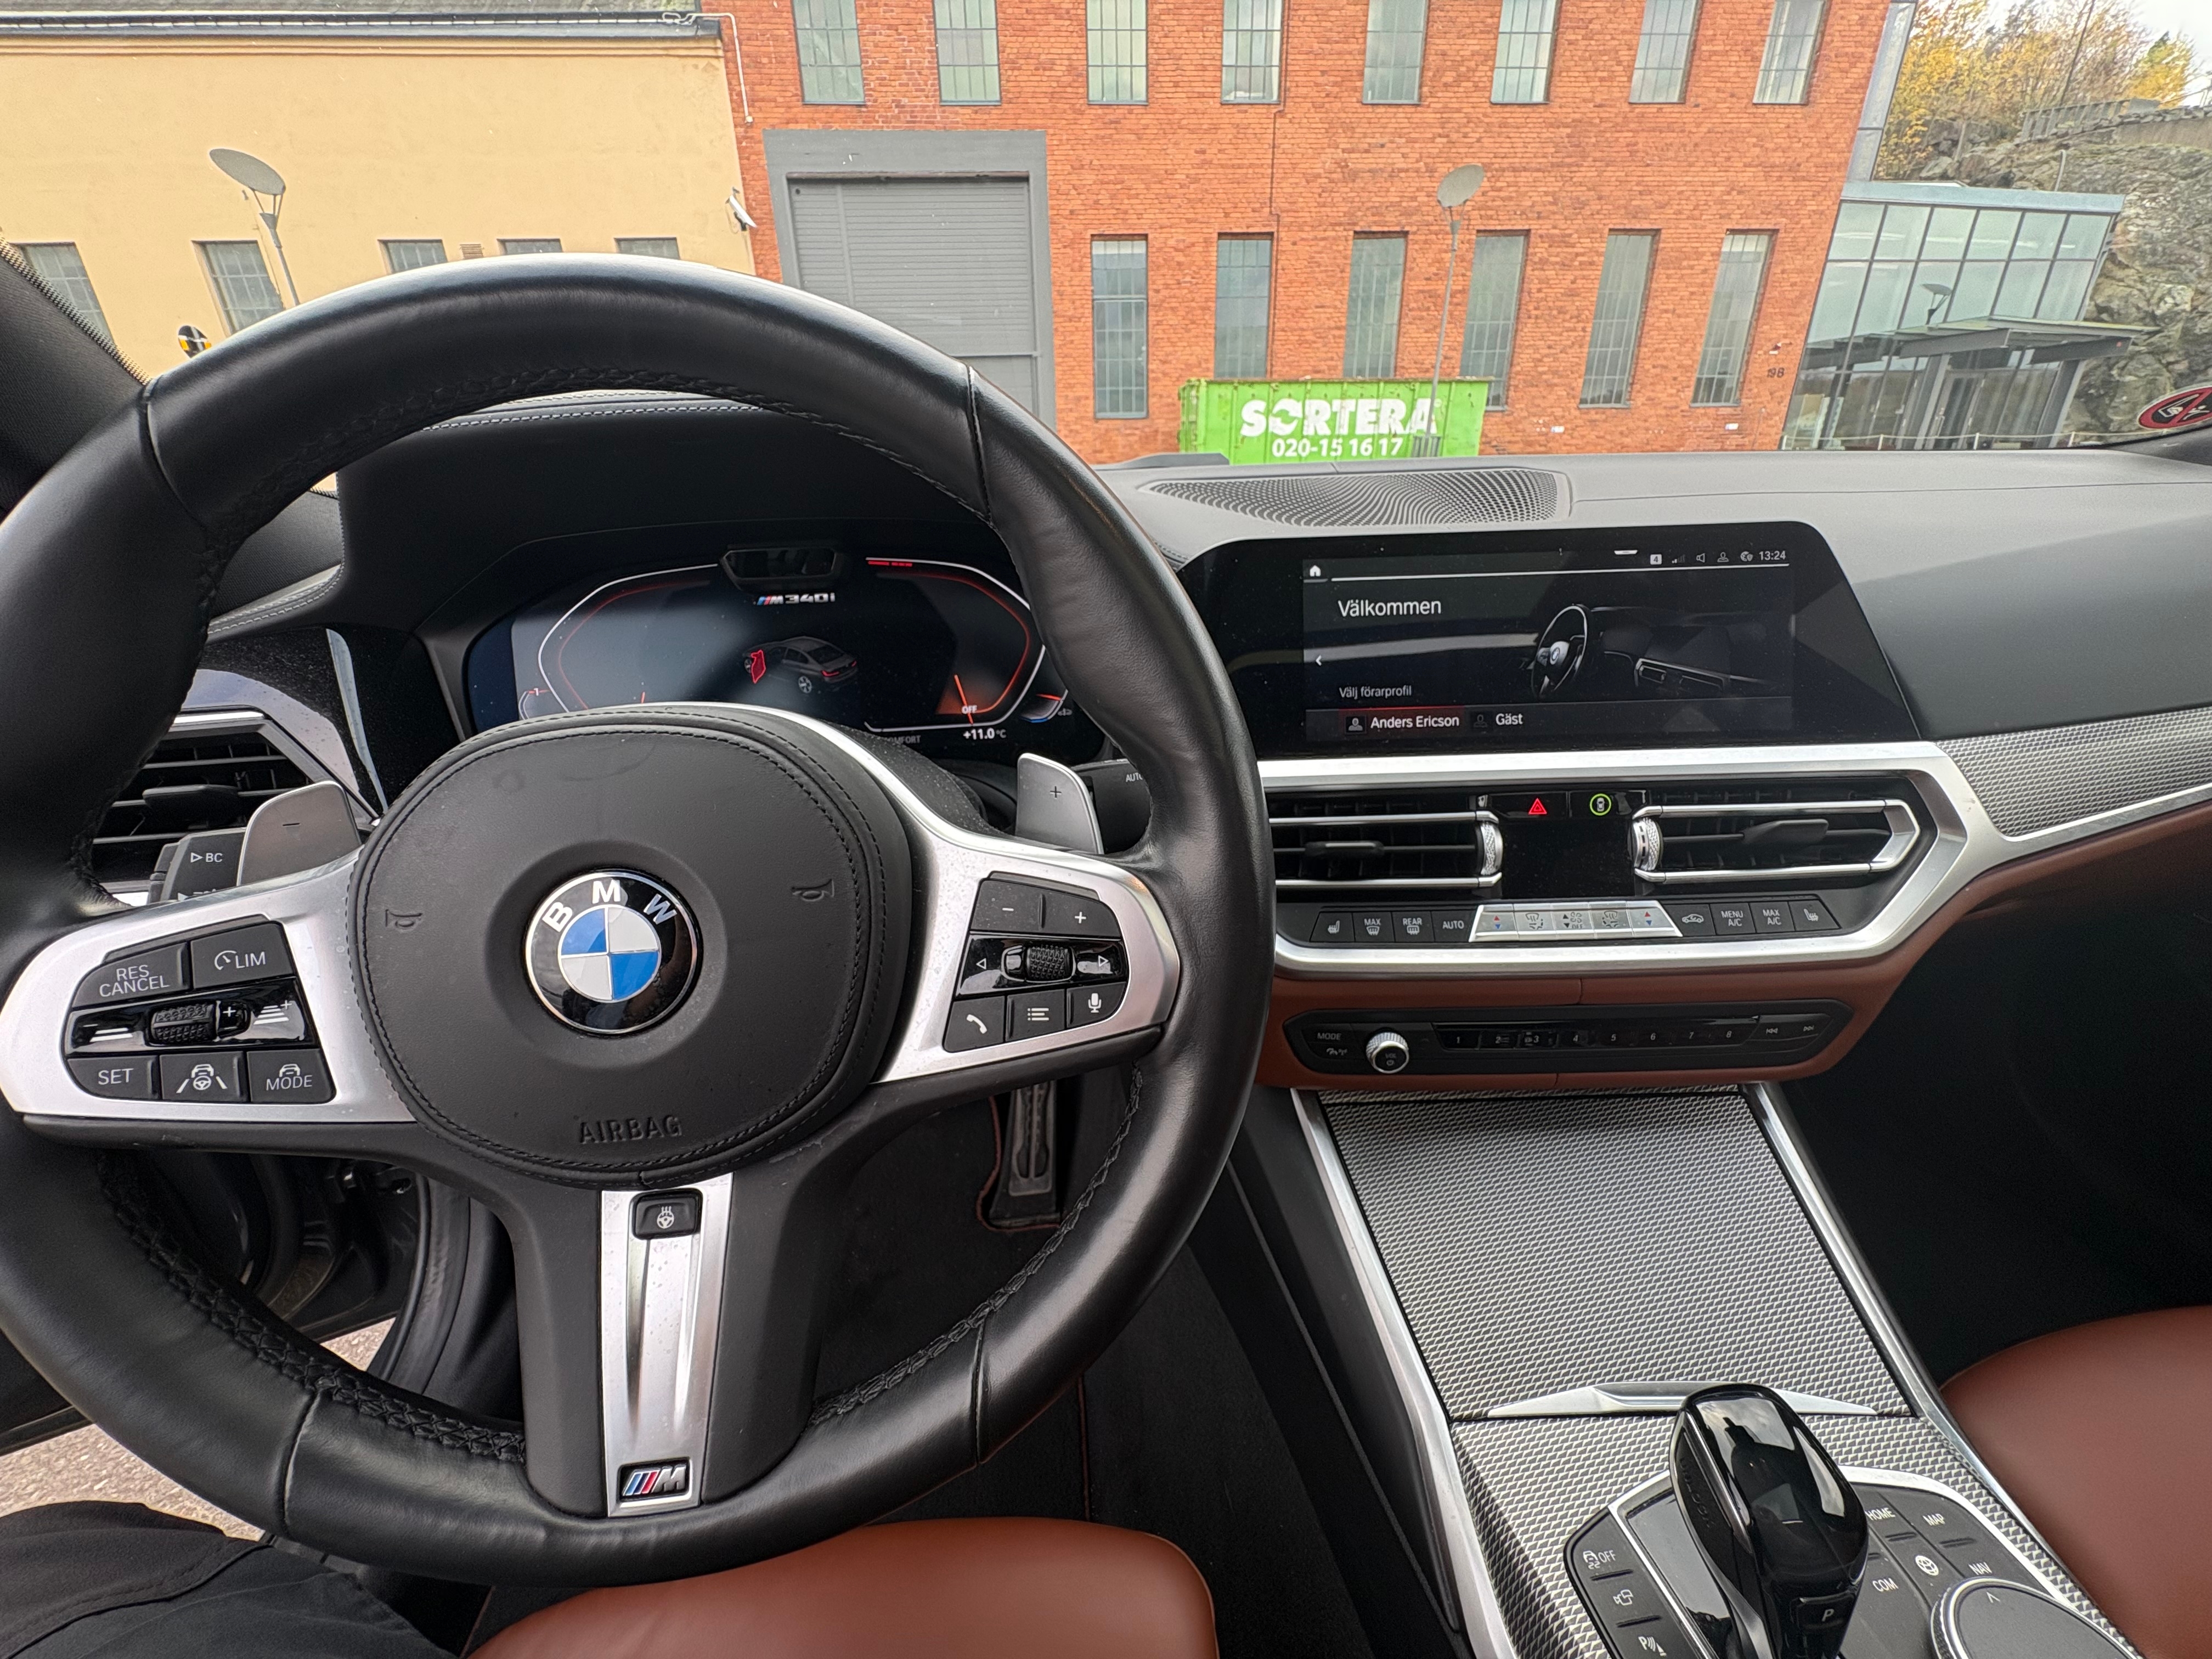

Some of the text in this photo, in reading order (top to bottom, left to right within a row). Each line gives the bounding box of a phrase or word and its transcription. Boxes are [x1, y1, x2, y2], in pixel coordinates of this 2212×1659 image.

[1240, 398, 1438, 437] SORTERA
[1272, 438, 1403, 457] 020-15 16 17
[1759, 550, 1786, 561] 13:24
[1338, 600, 1442, 617] Välkommen
[1339, 685, 1412, 700] Välj förarprofil
[962, 706, 978, 714] OFF
[1370, 714, 1460, 729] Anders Ericson
[1496, 713, 1523, 725] Gäst
[963, 728, 995, 740] +11.0
[206, 853, 223, 862] BC
[543, 879, 676, 932] BMW
[1442, 921, 1464, 929] AUTO
[1728, 918, 1742, 927] A/C
[1767, 917, 1782, 925] A/C
[235, 952, 267, 969] LIM
[116, 964, 149, 981] RES
[99, 975, 170, 997] CANCEL
[98, 1069, 133, 1085] SET
[266, 1075, 313, 1091] MODE
[580, 1115, 682, 1144] AIRBAG
[1865, 1507, 1895, 1521] HOME
[1922, 1513, 1945, 1526] MAP
[1598, 1550, 1616, 1562] OFF
[1968, 1562, 1993, 1575] NAV
[1872, 1578, 1899, 1592] COM
[1822, 1609, 1835, 1622] P
